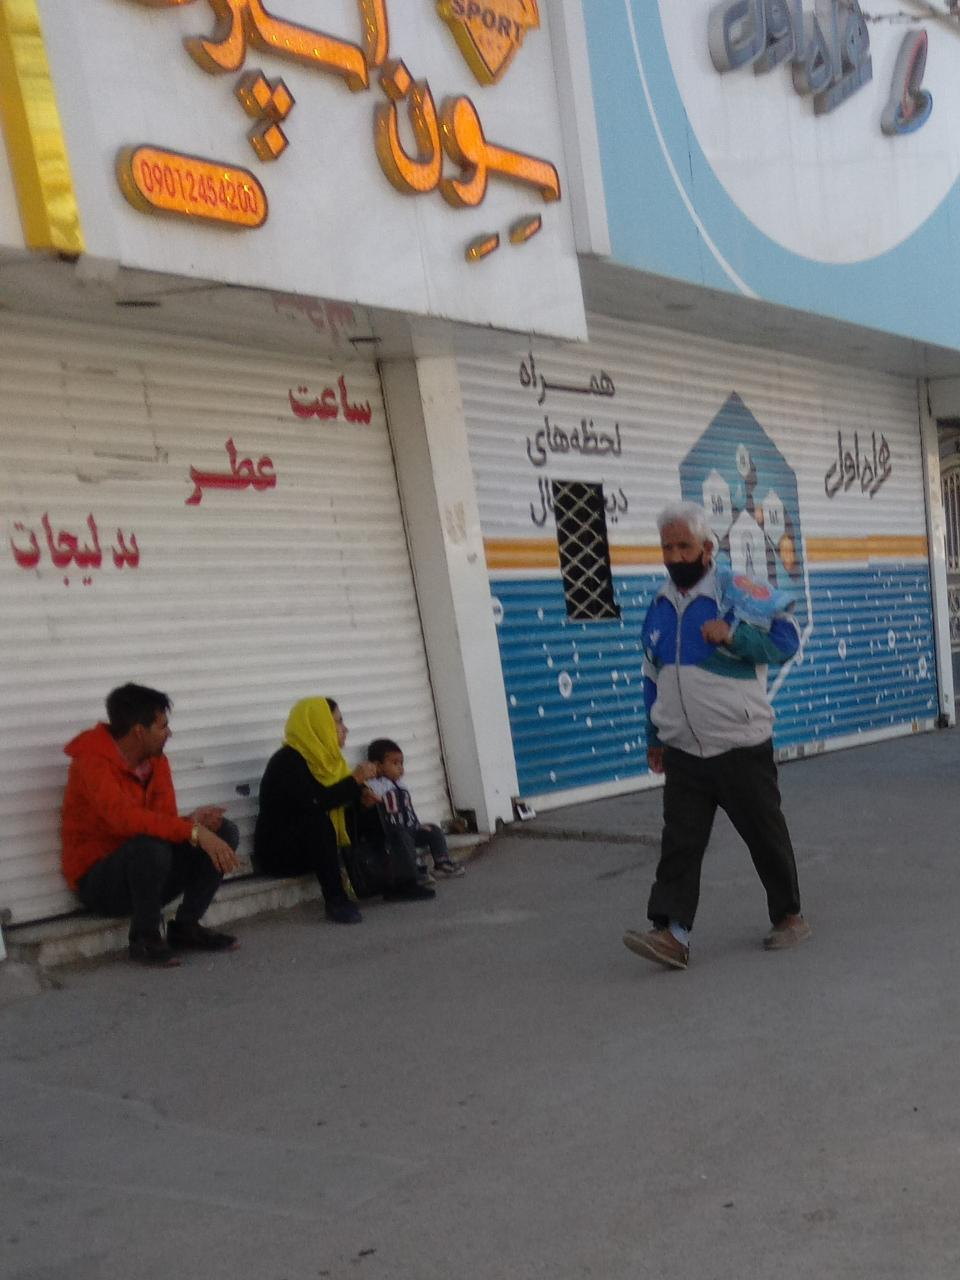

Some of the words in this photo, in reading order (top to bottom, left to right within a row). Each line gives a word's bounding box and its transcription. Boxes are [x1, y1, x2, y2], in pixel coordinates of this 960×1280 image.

[288, 374, 372, 426] ساعت
[518, 351, 616, 405] همراه
[185, 437, 277, 506] عطر
[529, 476, 629, 527] دیال
